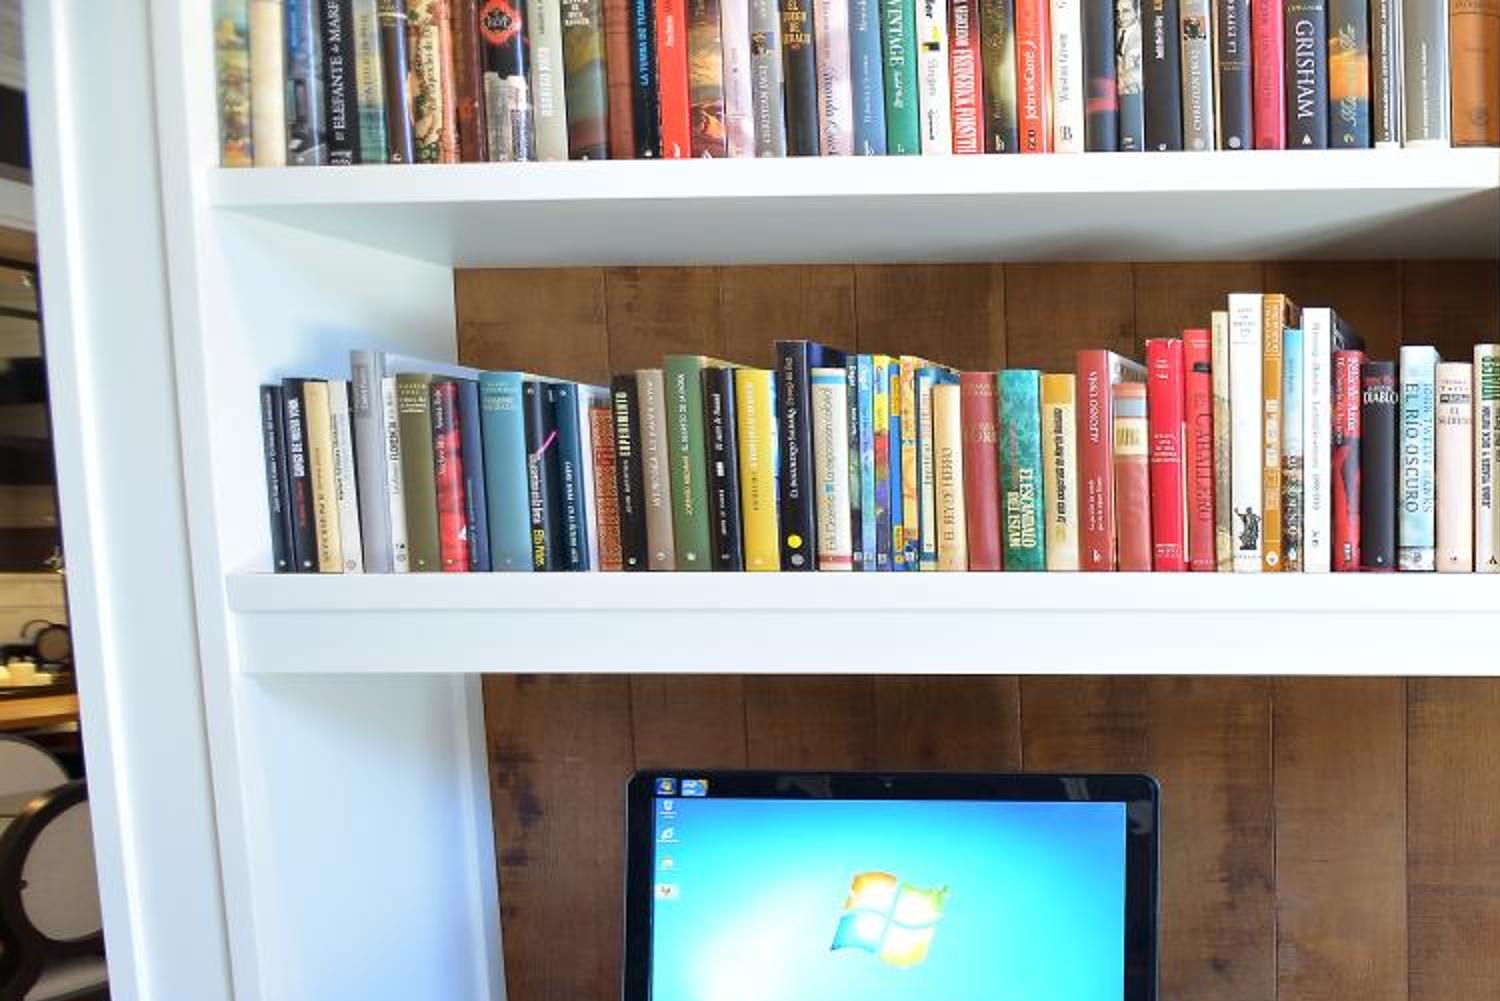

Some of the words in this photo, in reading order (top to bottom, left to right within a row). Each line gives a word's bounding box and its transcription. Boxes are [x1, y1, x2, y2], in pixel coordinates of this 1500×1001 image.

[1296, 18, 1316, 119] GRISHAM
[329, 55, 346, 129] ELEFANTE
[1024, 93, 1039, 120] John
[1363, 391, 1398, 405] DIABLO
[1405, 383, 1419, 401] EL
[1089, 399, 1100, 443] ALFONSO
[1405, 408, 1423, 439] RÍO
[1405, 443, 1419, 514] OSCURO
